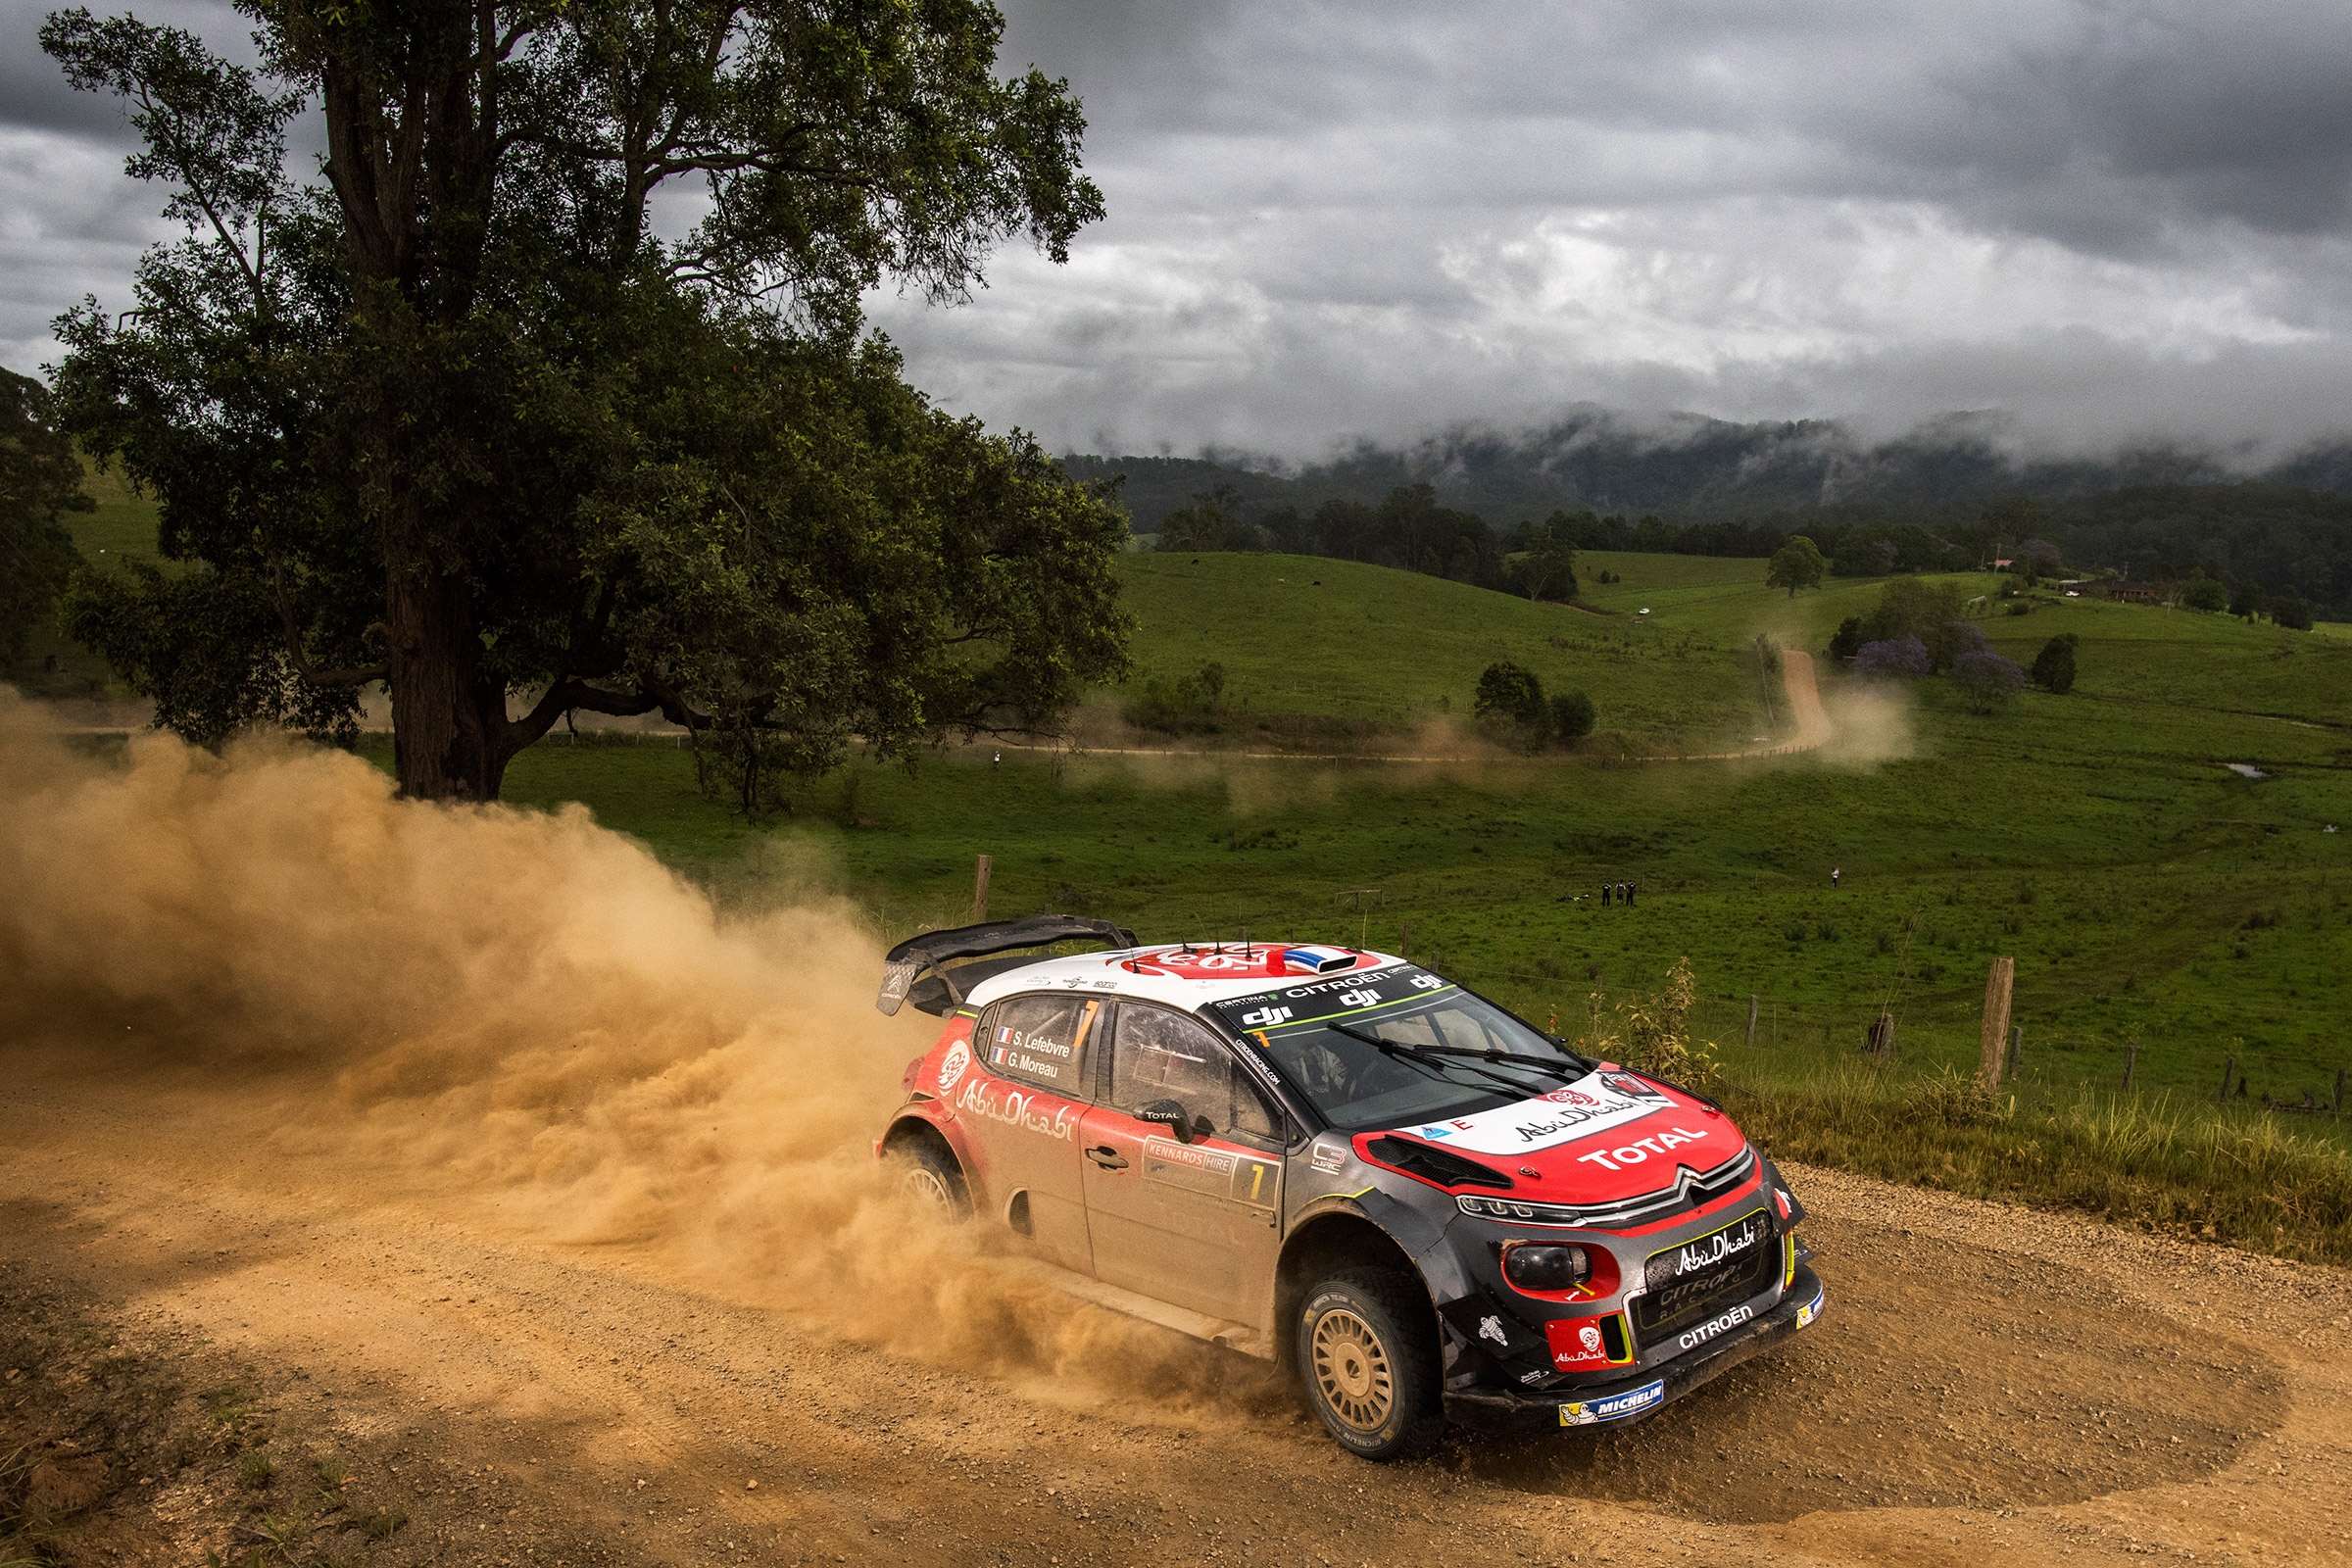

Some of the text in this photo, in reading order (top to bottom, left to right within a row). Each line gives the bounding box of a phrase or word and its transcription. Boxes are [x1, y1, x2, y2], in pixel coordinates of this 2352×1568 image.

[1286, 972, 1391, 998] CITROËN
[1215, 995, 1268, 1007] CERTINA
[1012, 1031, 1070, 1057] S. Lefebvre
[1007, 1052, 1058, 1078] G. Moreau
[1449, 1119, 1474, 1131] E
[1149, 1144, 1231, 1171] KENNARDS HIRE
[1577, 1127, 1709, 1170] TOTAL
[1311, 1158, 1342, 1172] WRC
[1250, 1164, 1264, 1200] 1
[1679, 1305, 1754, 1349] CITROËN
[1597, 1386, 1662, 1414] MICHELIN
